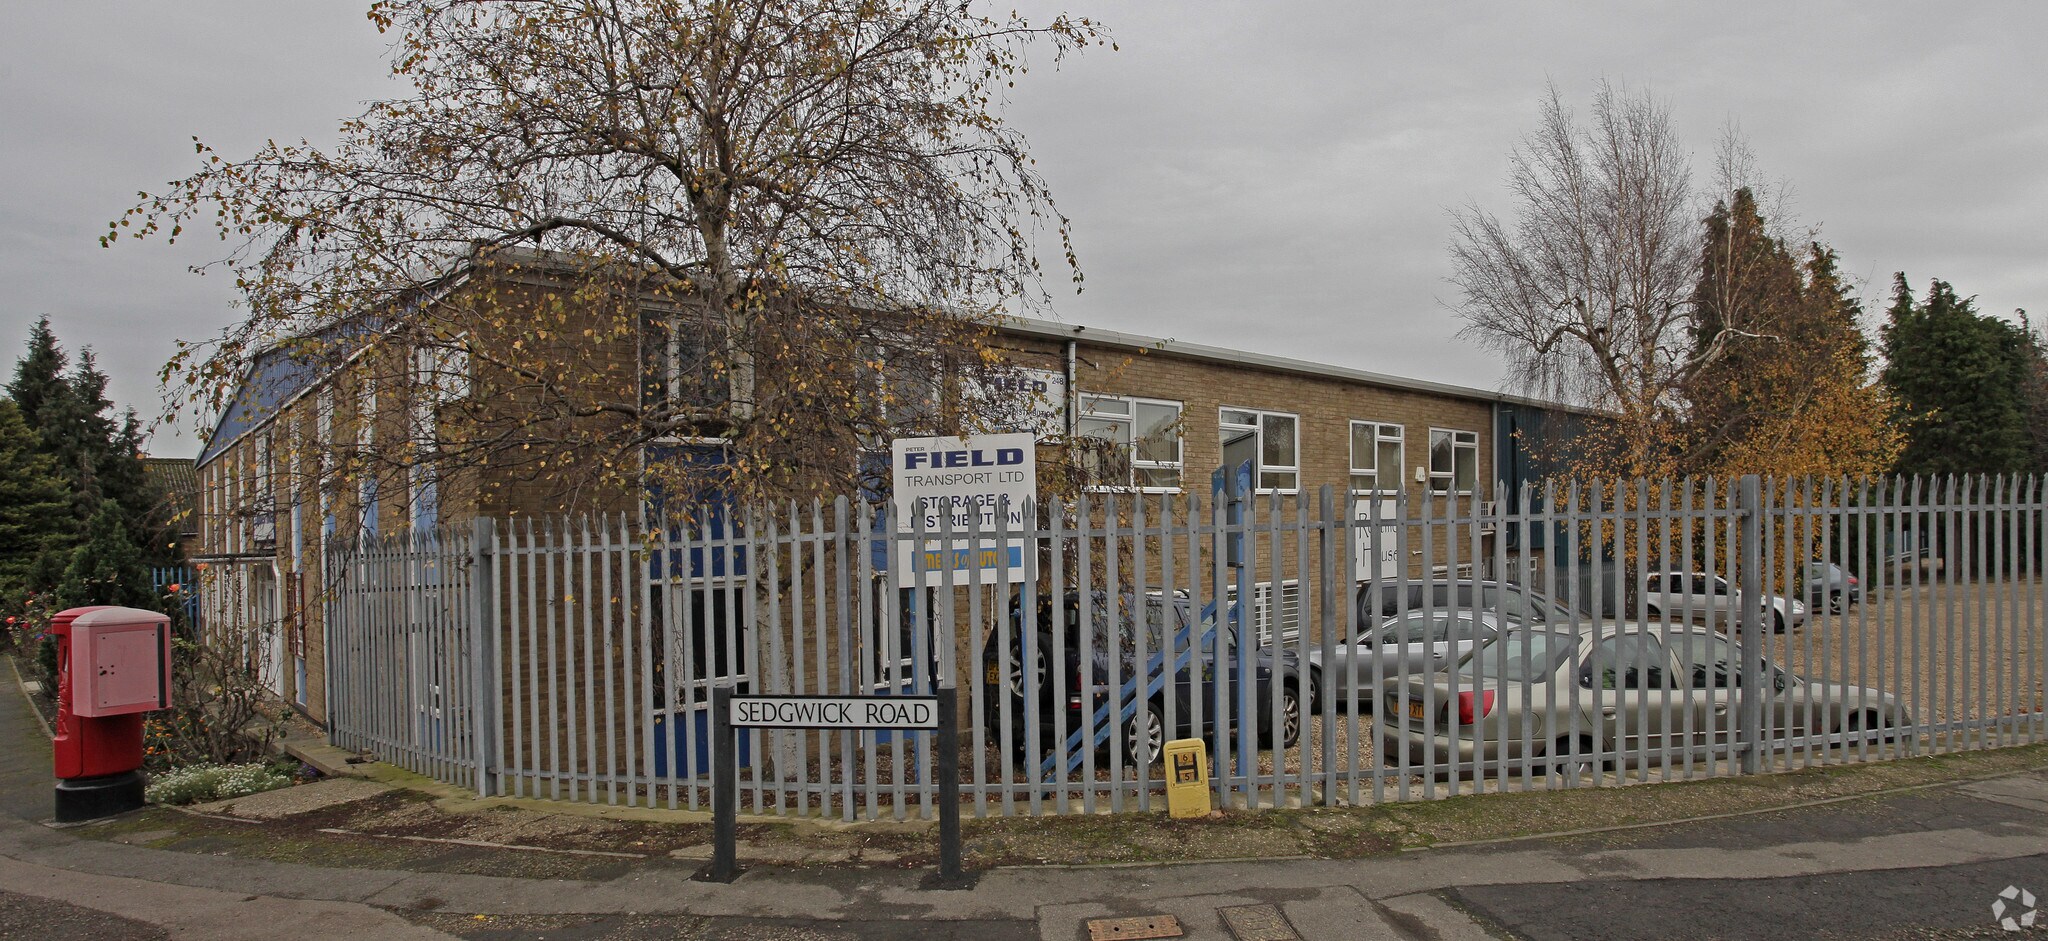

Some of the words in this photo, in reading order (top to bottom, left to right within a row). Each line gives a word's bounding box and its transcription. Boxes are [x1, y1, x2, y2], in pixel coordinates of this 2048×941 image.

[904, 448, 1024, 470] FIELD
[905, 472, 992, 487] TRANSPORT
[999, 471, 1024, 483] LTD
[910, 511, 1020, 529] SRIBTN
[1362, 542, 1399, 567] Huse
[738, 701, 853, 724] SEDGWICK
[865, 703, 930, 724] ROAD
[1173, 752, 1200, 784] H
[1182, 754, 1188, 762] 6
[1184, 773, 1190, 781] 5
